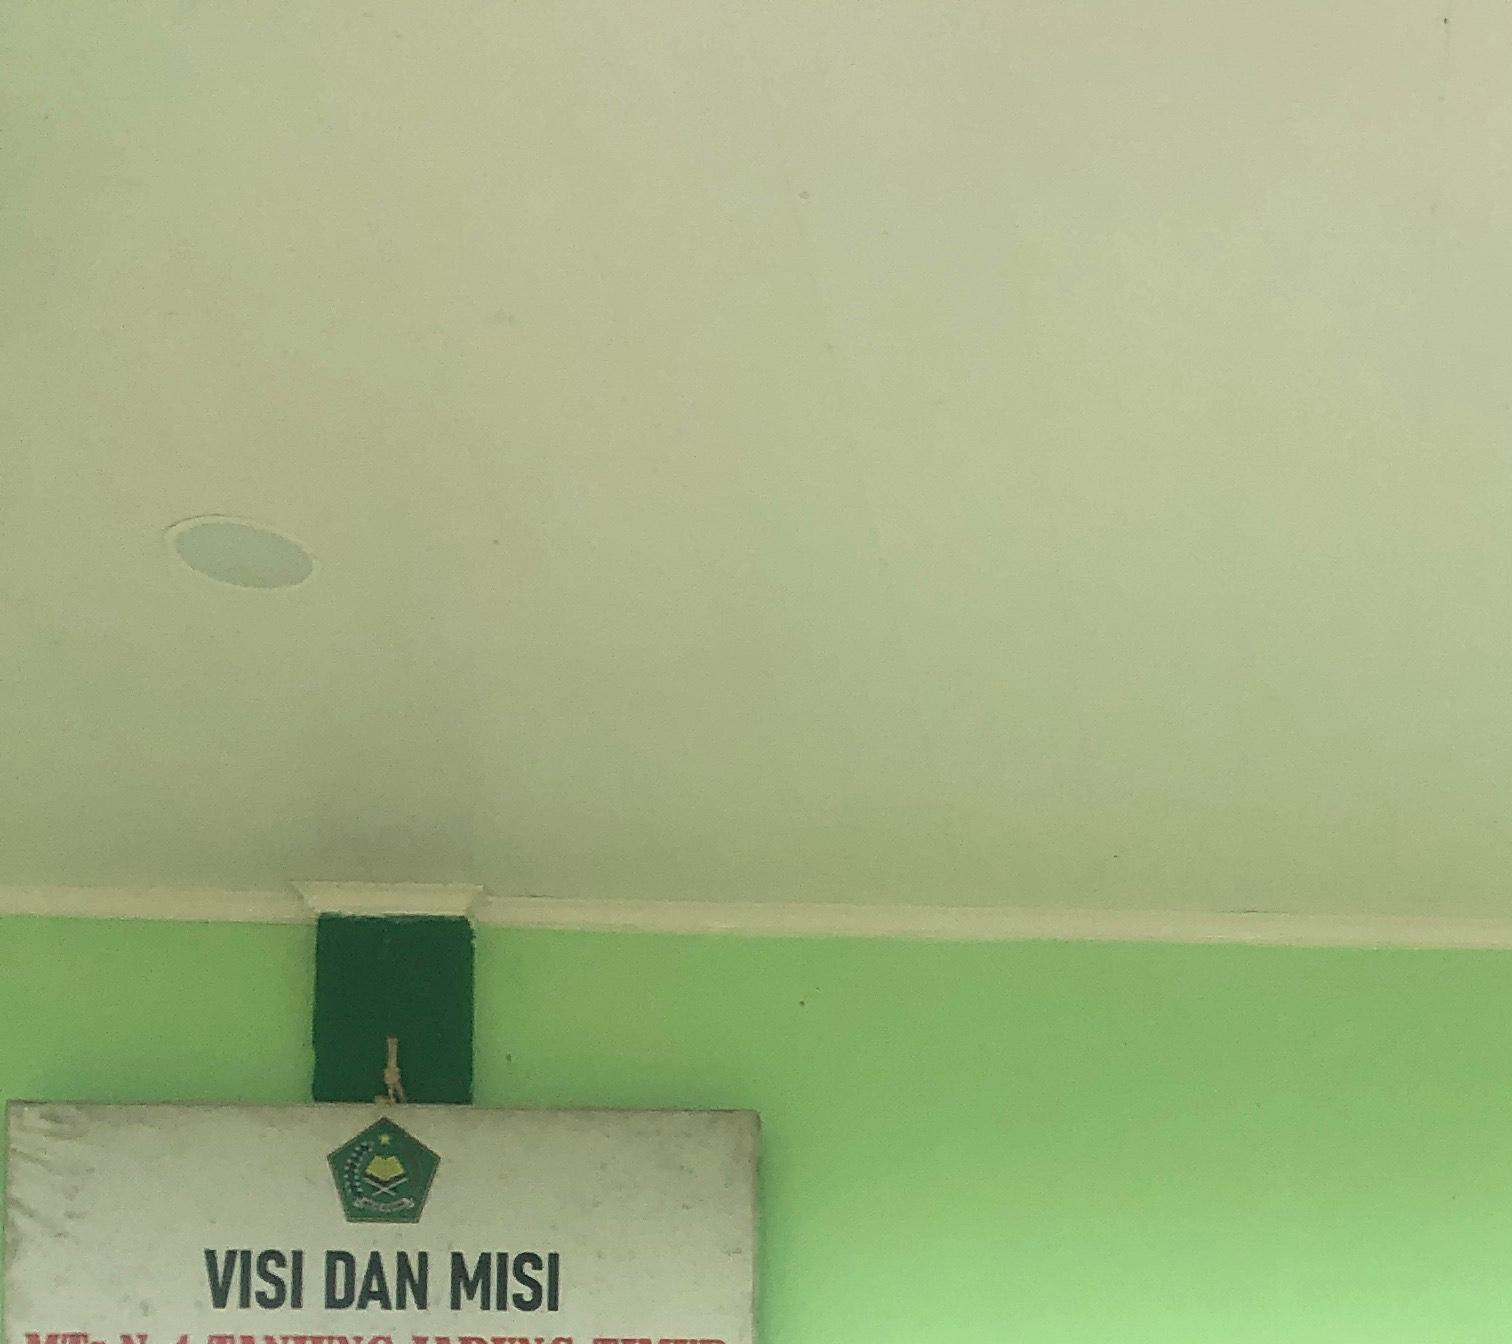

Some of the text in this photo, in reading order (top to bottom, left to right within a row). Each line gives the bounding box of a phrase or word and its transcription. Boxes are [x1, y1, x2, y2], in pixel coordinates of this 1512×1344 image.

[204, 1249, 559, 1312] VISI DAN MISI
